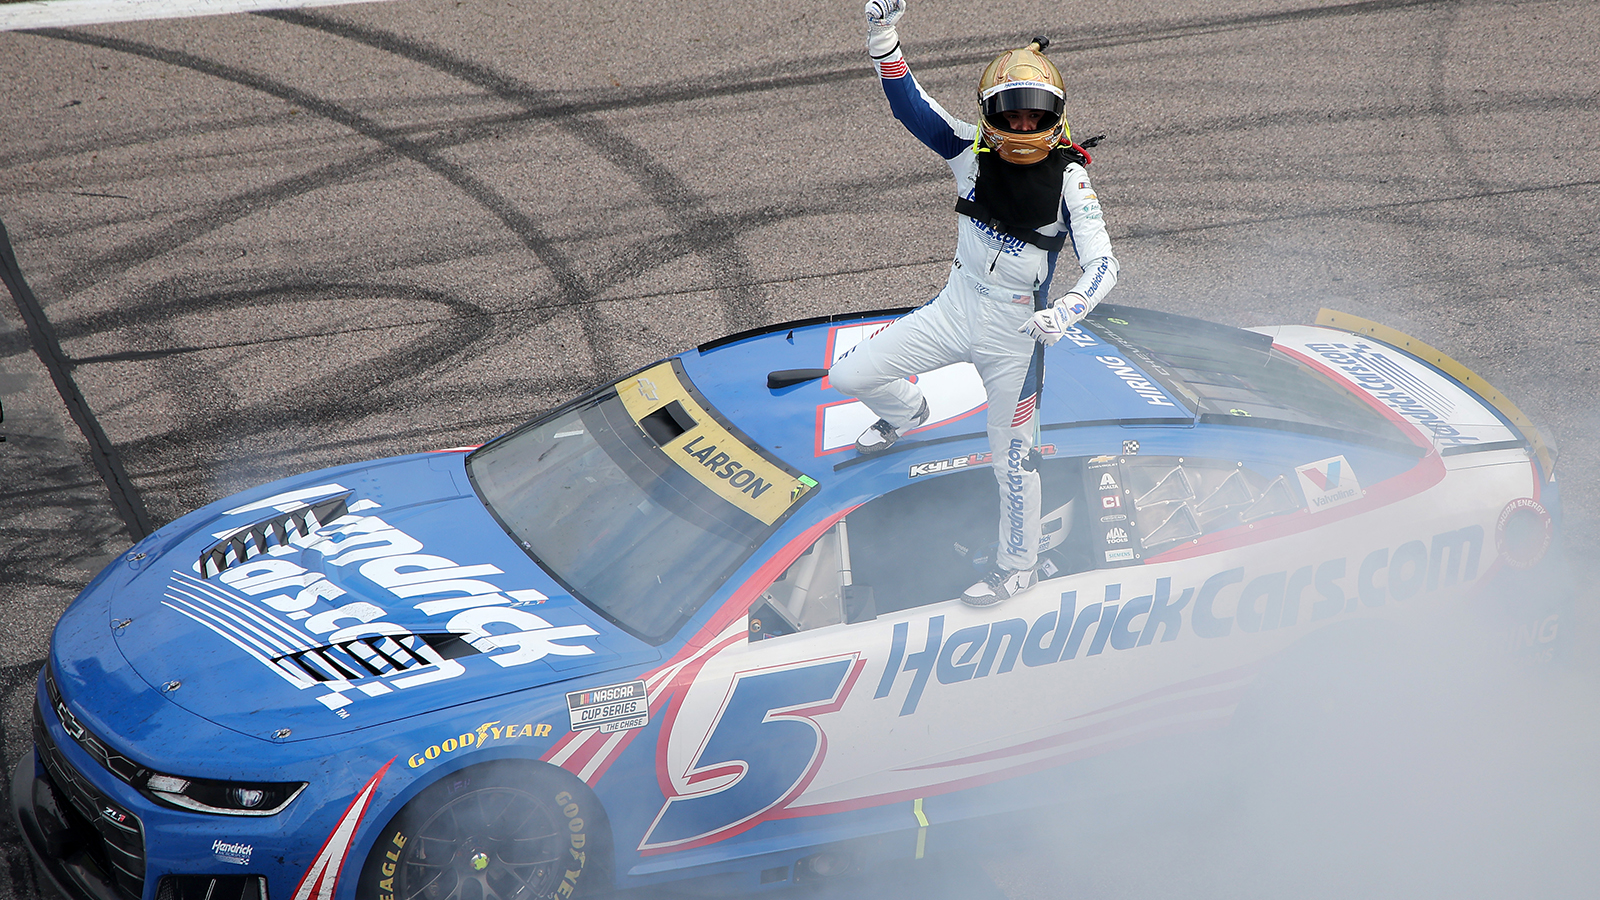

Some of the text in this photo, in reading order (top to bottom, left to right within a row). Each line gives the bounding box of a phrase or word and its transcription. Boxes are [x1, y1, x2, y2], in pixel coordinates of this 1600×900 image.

[1095, 355, 1176, 407] HIRING
[681, 435, 773, 500] LARSON
[1497, 498, 1546, 532] PHORM ENERGY
[1106, 527, 1128, 540] MAC
[1106, 537, 1129, 545] TOOLS
[873, 524, 1485, 717] HendrickCars.com
[593, 685, 634, 703] NASCAR
[581, 701, 637, 721] CUP SERIES
[606, 718, 643, 731] THE CHASE
[408, 720, 553, 769] GOODYEAR
[637, 651, 868, 857] 5
[102, 806, 126, 823] ZL1
[211, 839, 254, 856] Hendrick
